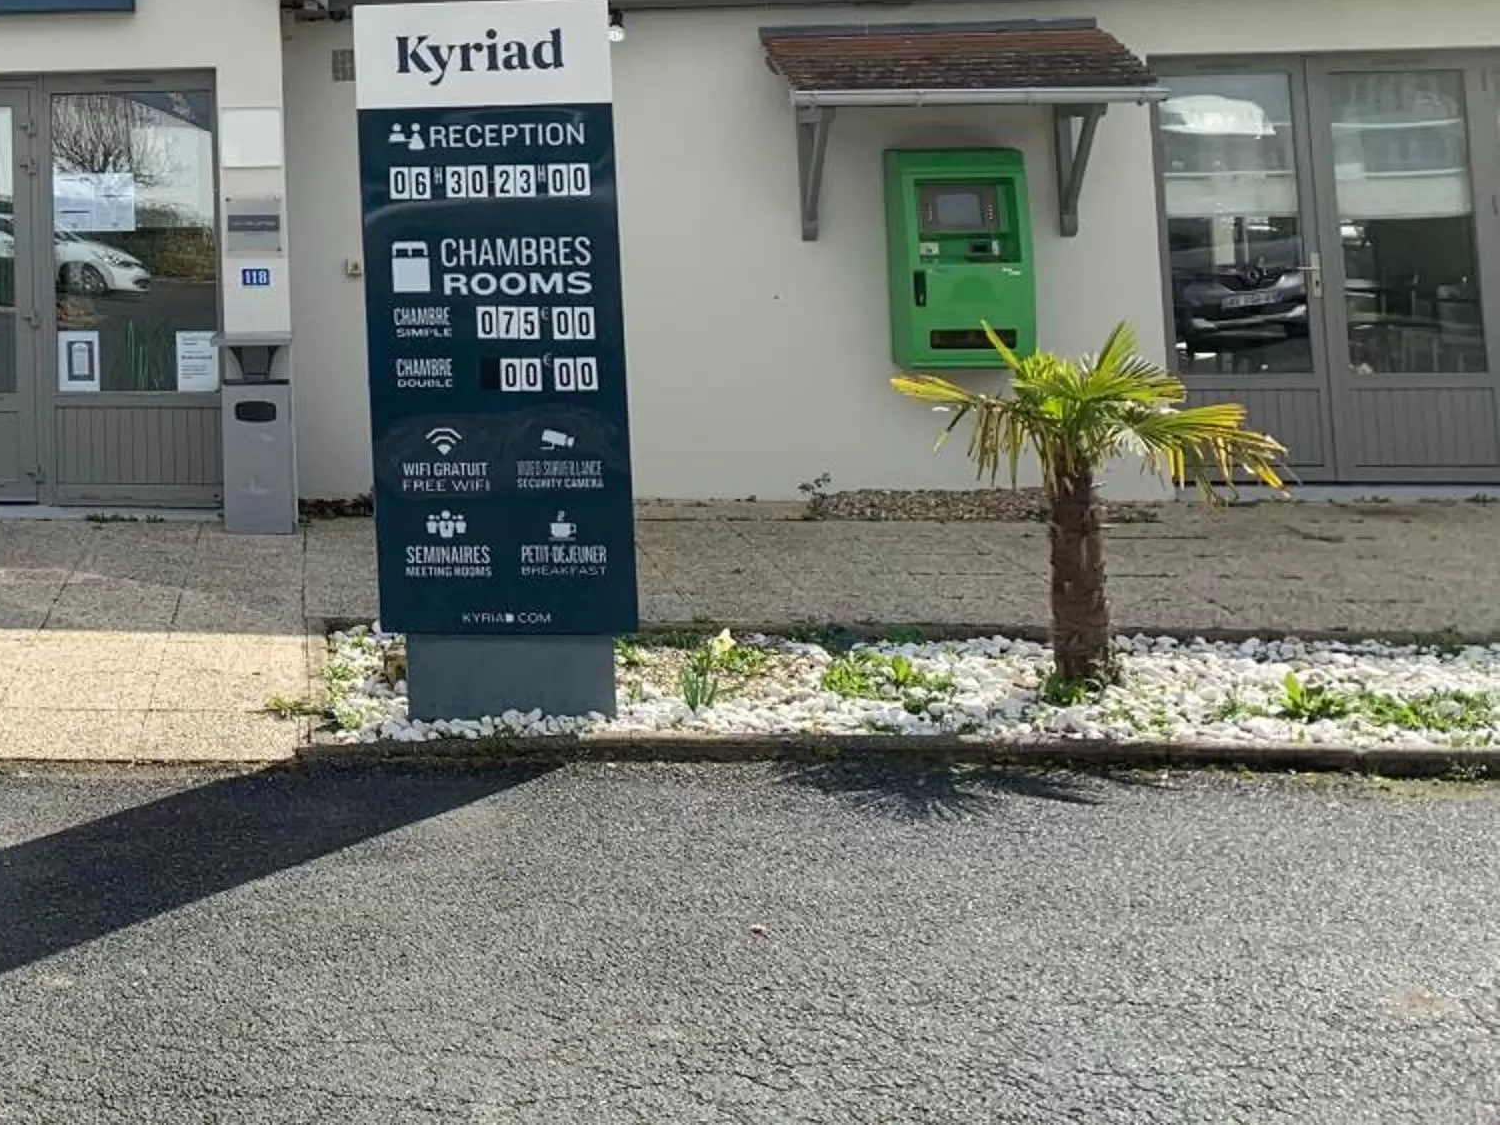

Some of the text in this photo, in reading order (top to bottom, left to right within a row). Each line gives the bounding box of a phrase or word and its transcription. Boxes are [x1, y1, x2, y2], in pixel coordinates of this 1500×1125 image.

[395, 28, 564, 86] Kyriad
[429, 122, 585, 148] RECEPTION
[440, 236, 592, 267] CHAMBRES
[443, 271, 593, 296] ROOMS
[393, 306, 451, 326] CHAMBRE
[396, 358, 453, 377] CHAMBRE
[402, 461, 488, 477] WIFI GRATUIT
[403, 478, 492, 492] FREE WIFI
[405, 545, 492, 564] SEMINAIRES
